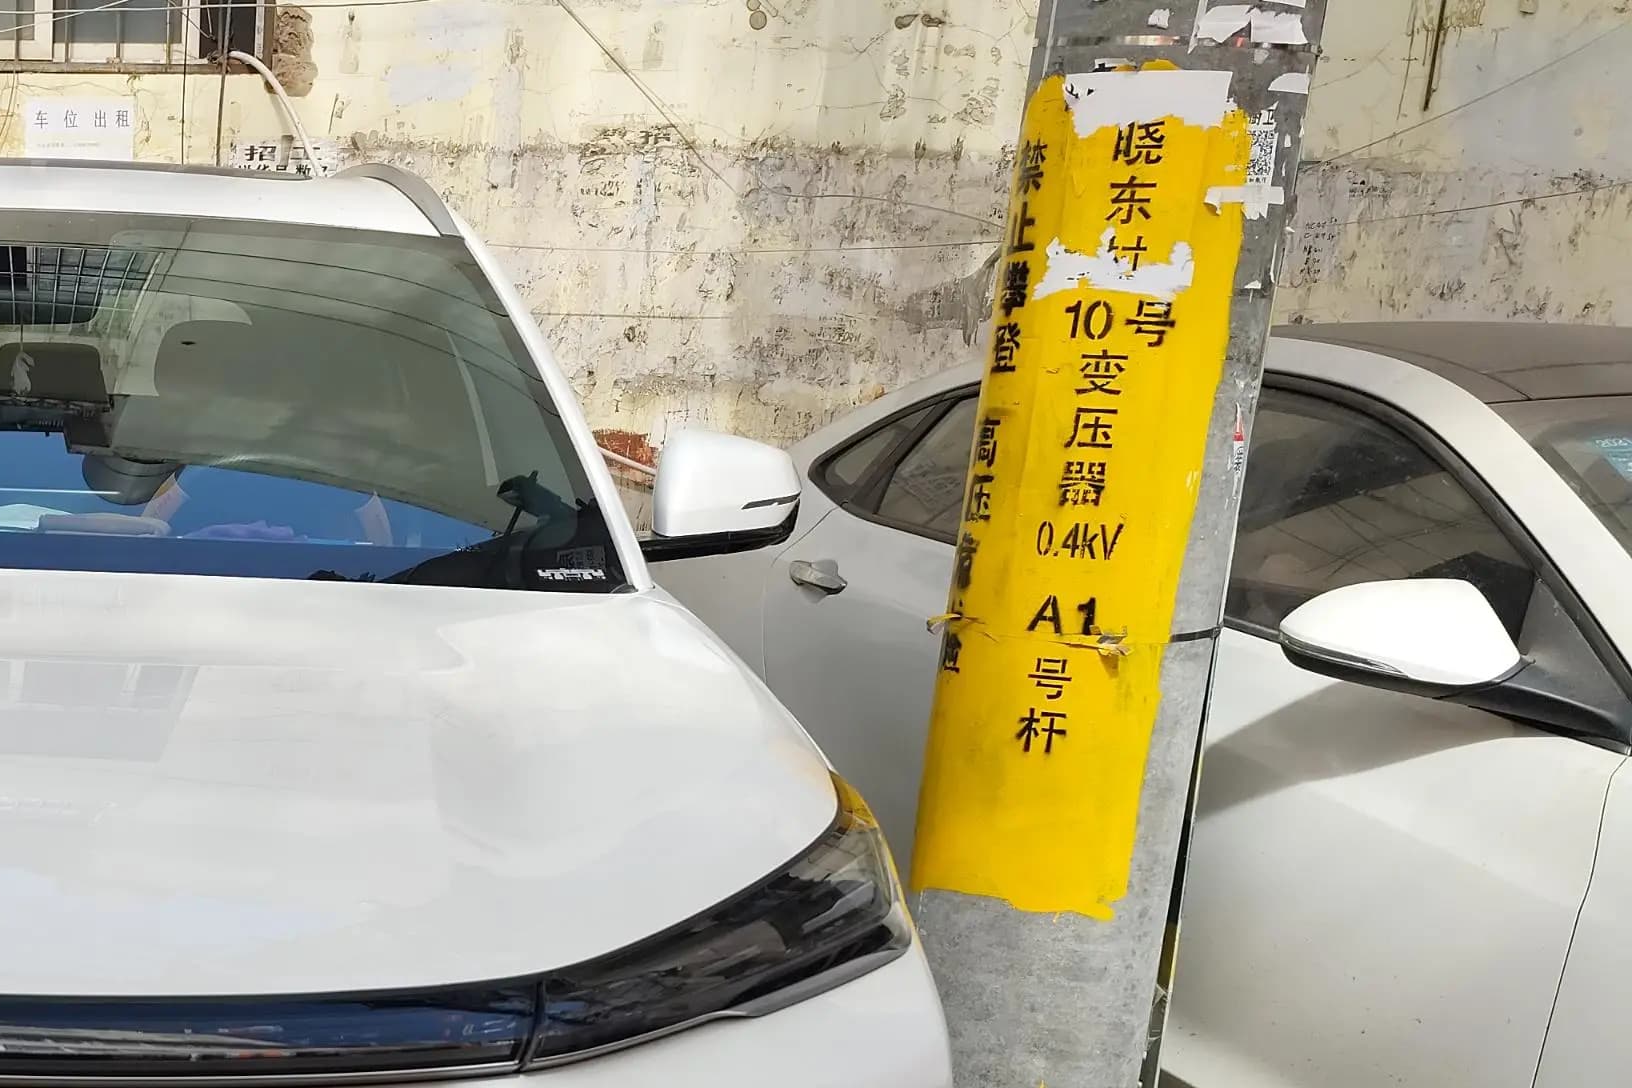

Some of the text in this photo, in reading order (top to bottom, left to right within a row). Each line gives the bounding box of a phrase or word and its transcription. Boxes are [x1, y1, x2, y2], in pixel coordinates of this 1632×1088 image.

[32, 109, 130, 129] 车位出租
[1065, 299, 1176, 347] 10号
[1058, 349, 1129, 507] 变压器
[1036, 520, 1125, 561] 0.4kV
[1026, 595, 1097, 636] A1
[1016, 658, 1073, 754] 号杆
